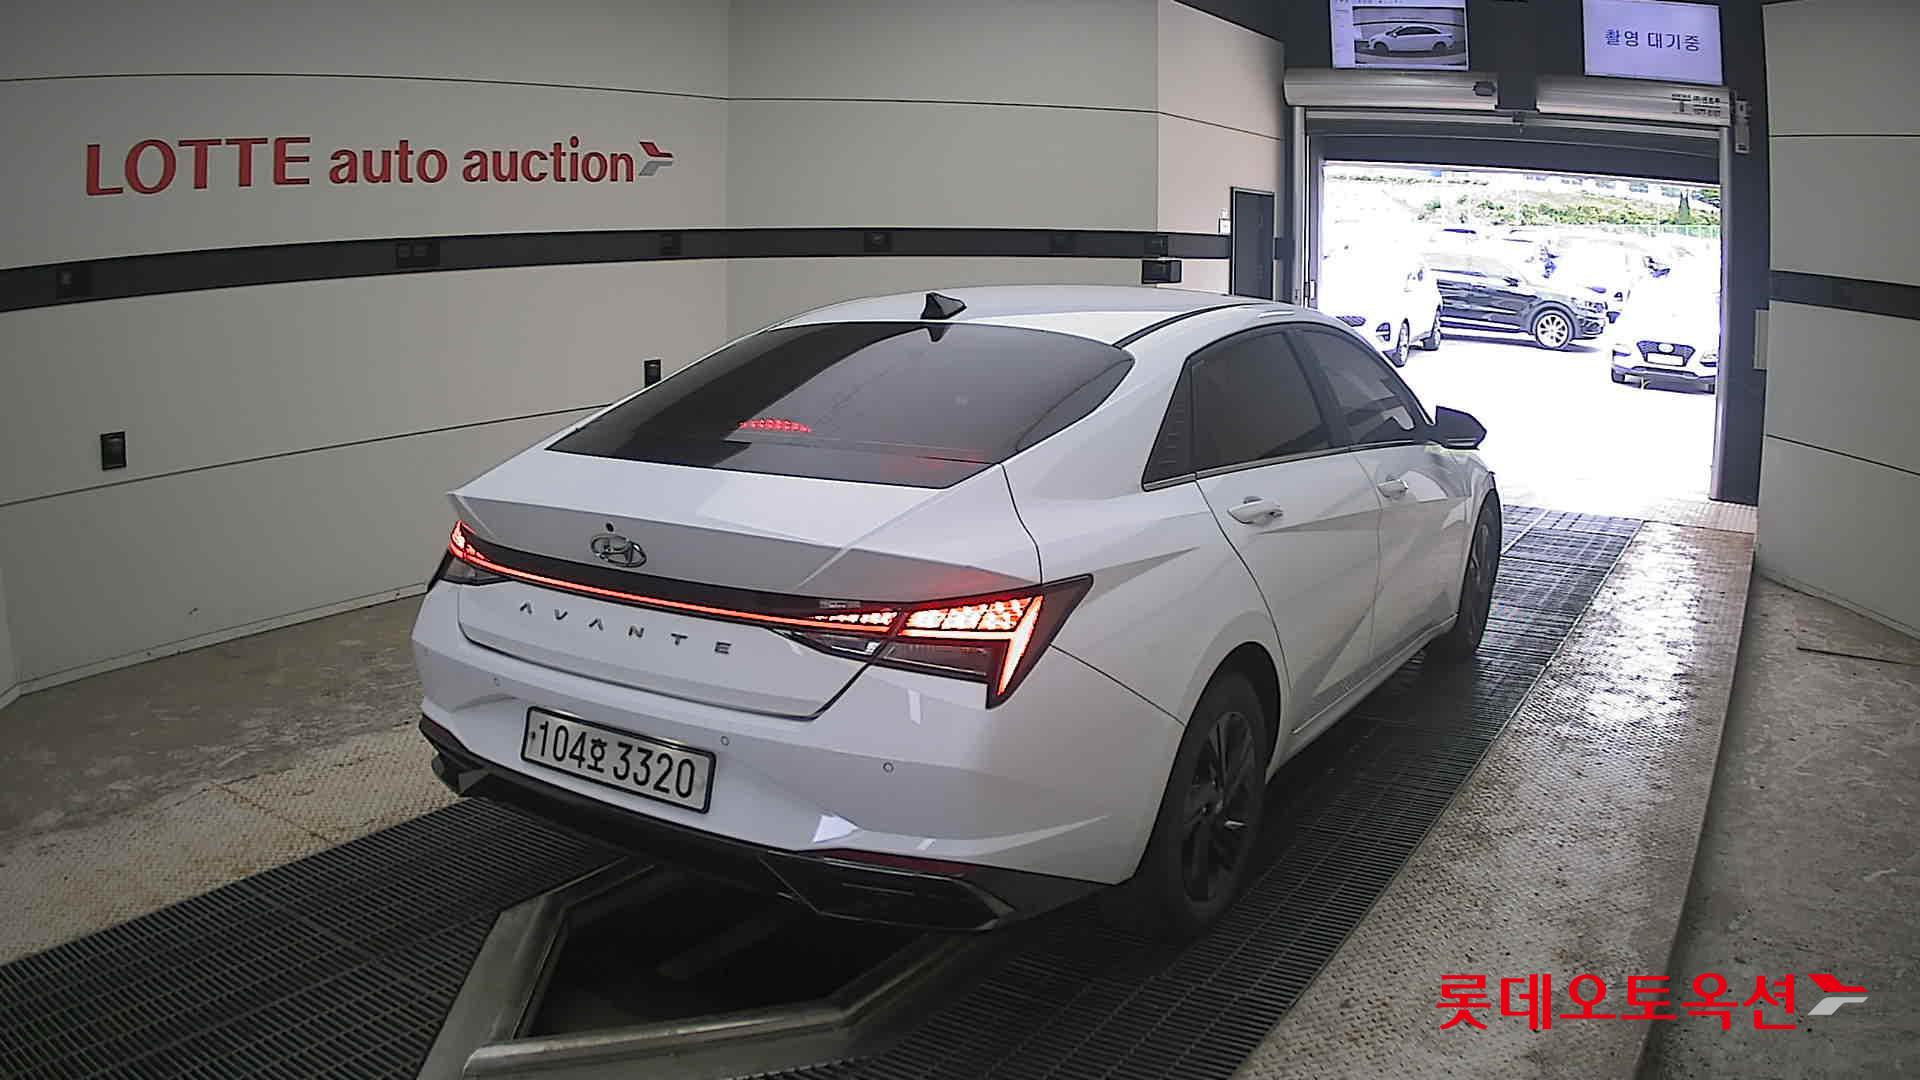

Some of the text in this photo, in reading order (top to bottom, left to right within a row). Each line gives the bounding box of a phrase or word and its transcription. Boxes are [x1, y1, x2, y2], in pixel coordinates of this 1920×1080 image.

[1605, 28, 1702, 53] 촬영 대기중
[86, 136, 635, 196] LOTTE auto auction
[519, 600, 732, 656] AVANTE
